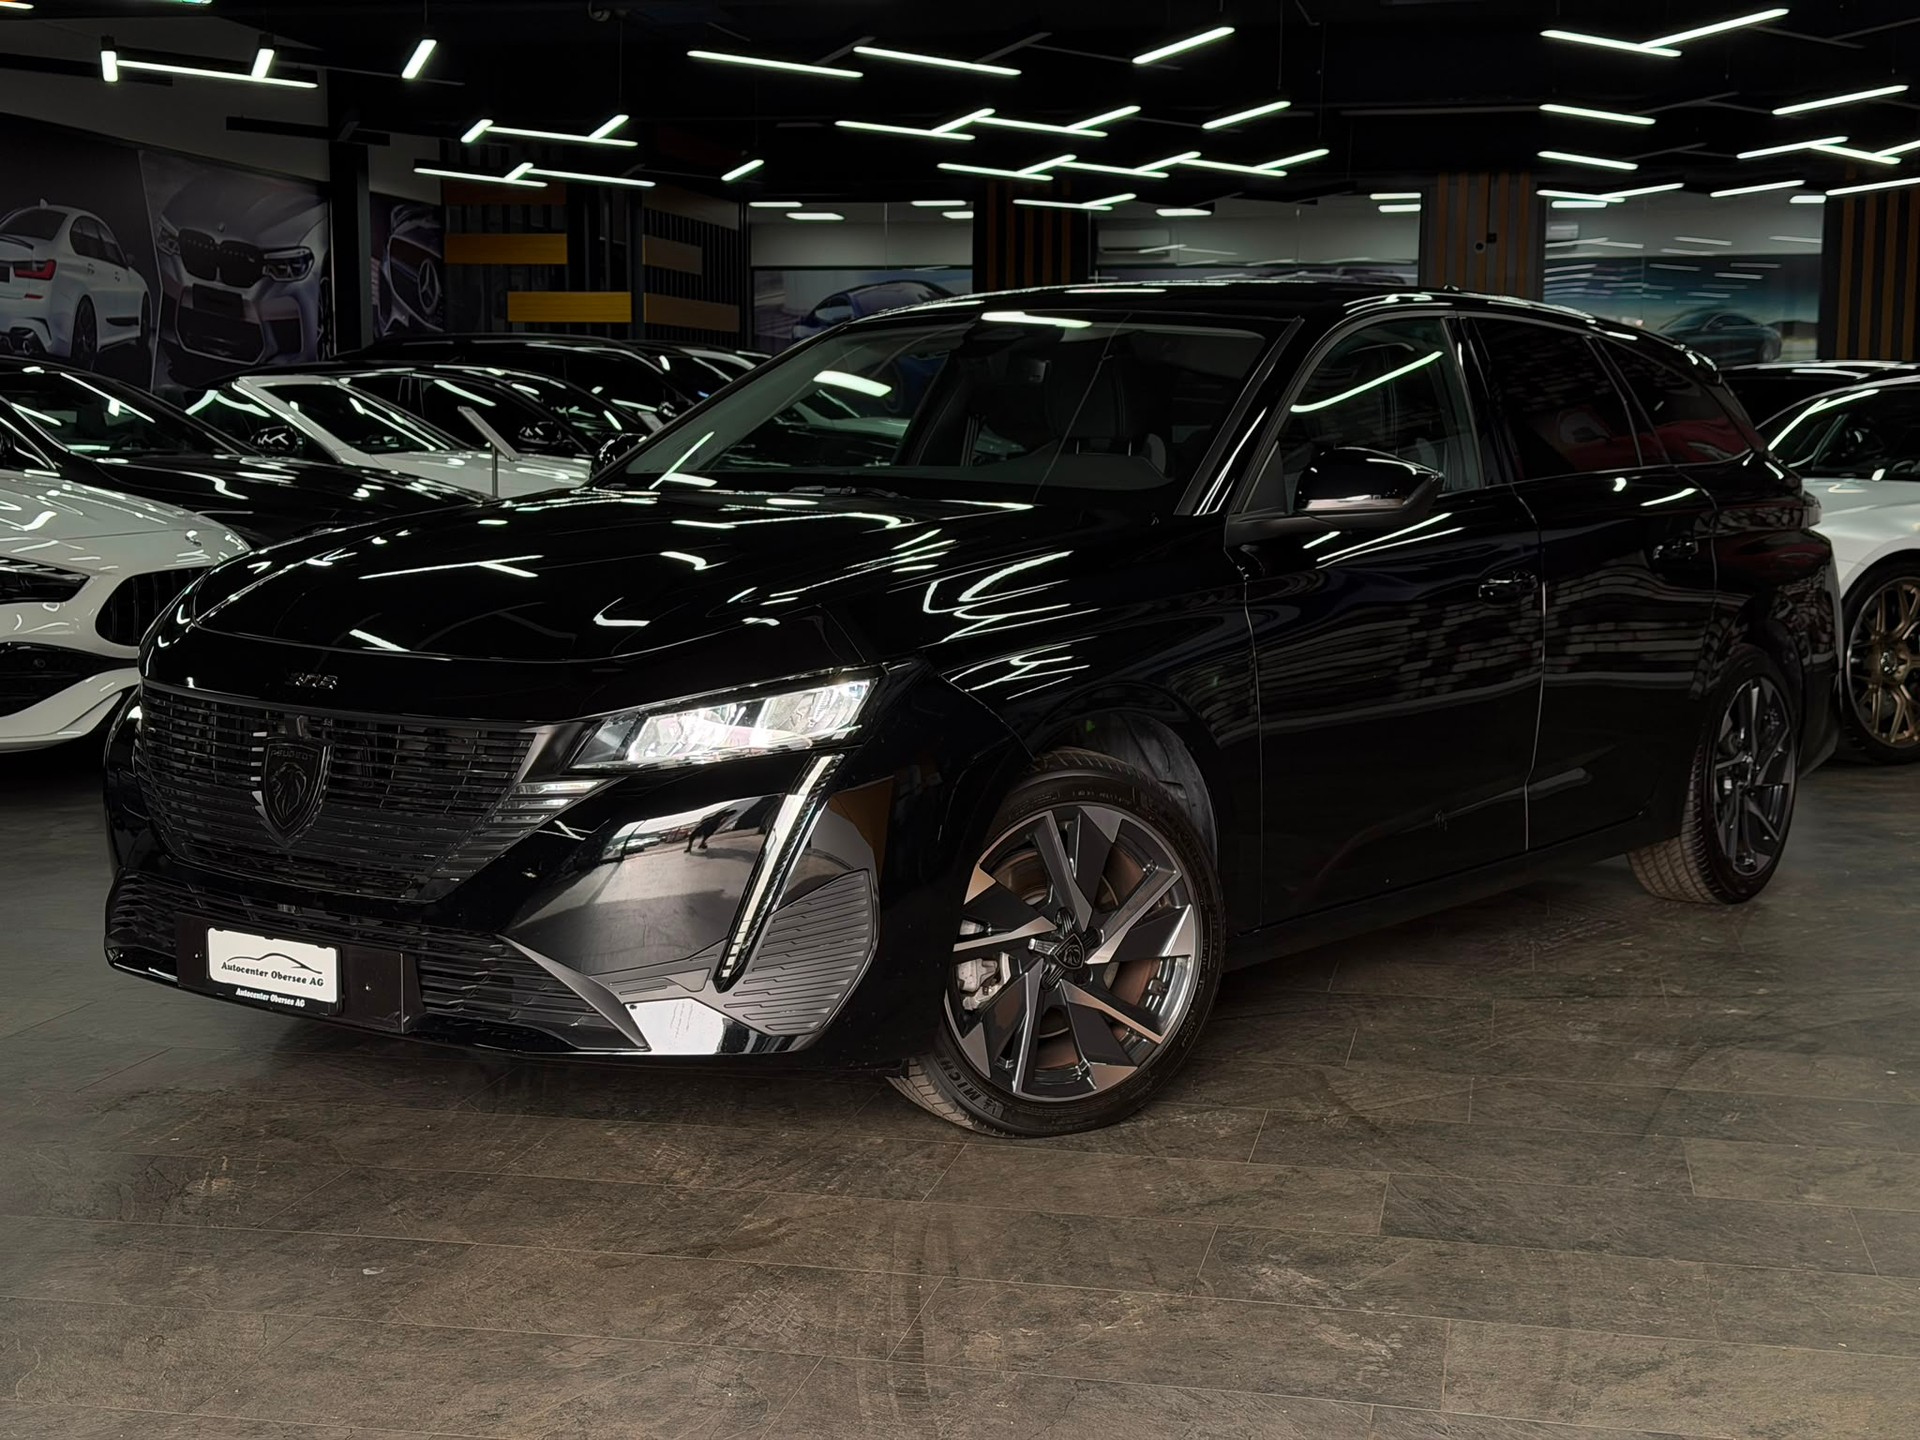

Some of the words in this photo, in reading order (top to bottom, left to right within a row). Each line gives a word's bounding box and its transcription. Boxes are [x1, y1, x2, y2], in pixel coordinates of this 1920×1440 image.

[221, 962, 268, 977] Autocenter
[271, 971, 306, 984] Obersee
[309, 977, 324, 986] AG
[236, 988, 269, 1001] Autocenter
[270, 994, 294, 1006] Obersee
[295, 998, 305, 1008] AG
